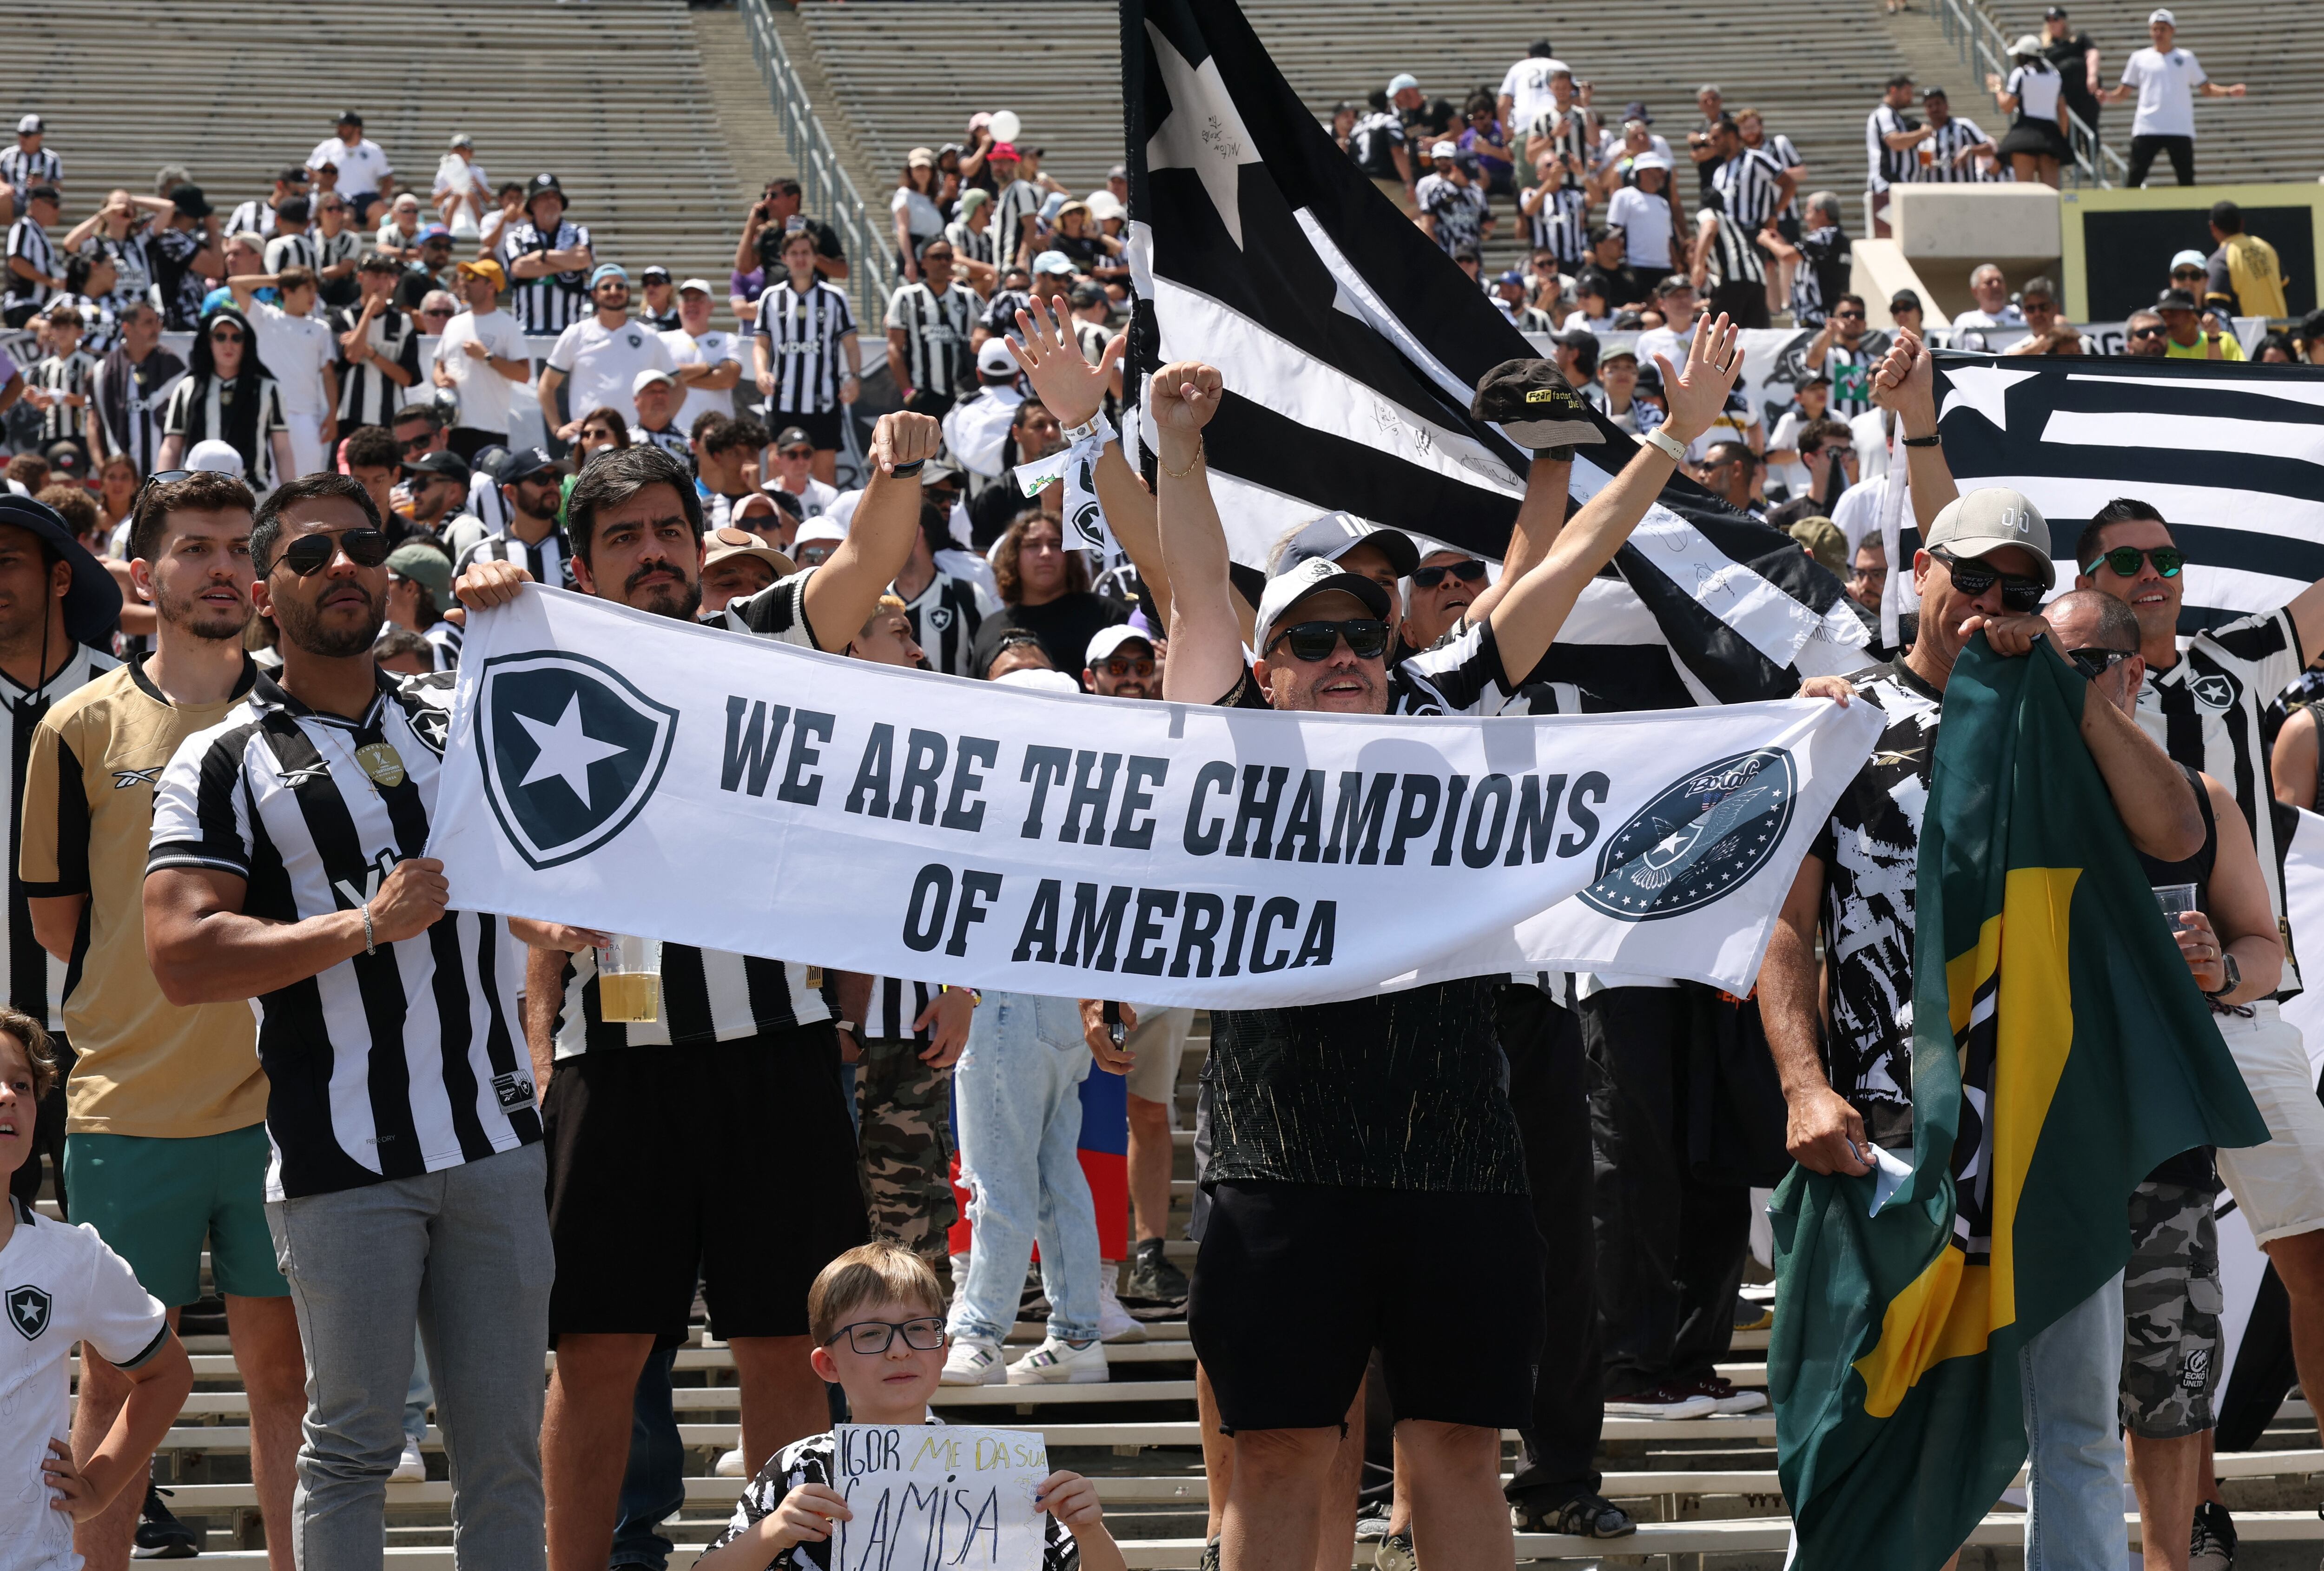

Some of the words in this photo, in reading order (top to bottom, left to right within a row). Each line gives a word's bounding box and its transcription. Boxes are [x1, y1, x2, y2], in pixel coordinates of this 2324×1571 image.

[1528, 391, 1551, 402] Fear
[1552, 391, 1571, 400] factor
[1568, 399, 1580, 409] LIVE
[720, 695, 836, 806] WE
[845, 722, 1000, 832] ARE
[1019, 744, 1169, 850] THE
[1183, 760, 1611, 869] CHAMPIONS
[902, 863, 1004, 957] OF
[1011, 878, 1337, 978] AMERICA
[499, 1087, 516, 1096] Reebok
[2183, 1379, 2203, 1387] UNLTD
[842, 1429, 900, 1477] IGOR
[910, 1436, 962, 1472] ME
[976, 1436, 1010, 1472] DA
[1013, 1444, 1046, 1468] SUA
